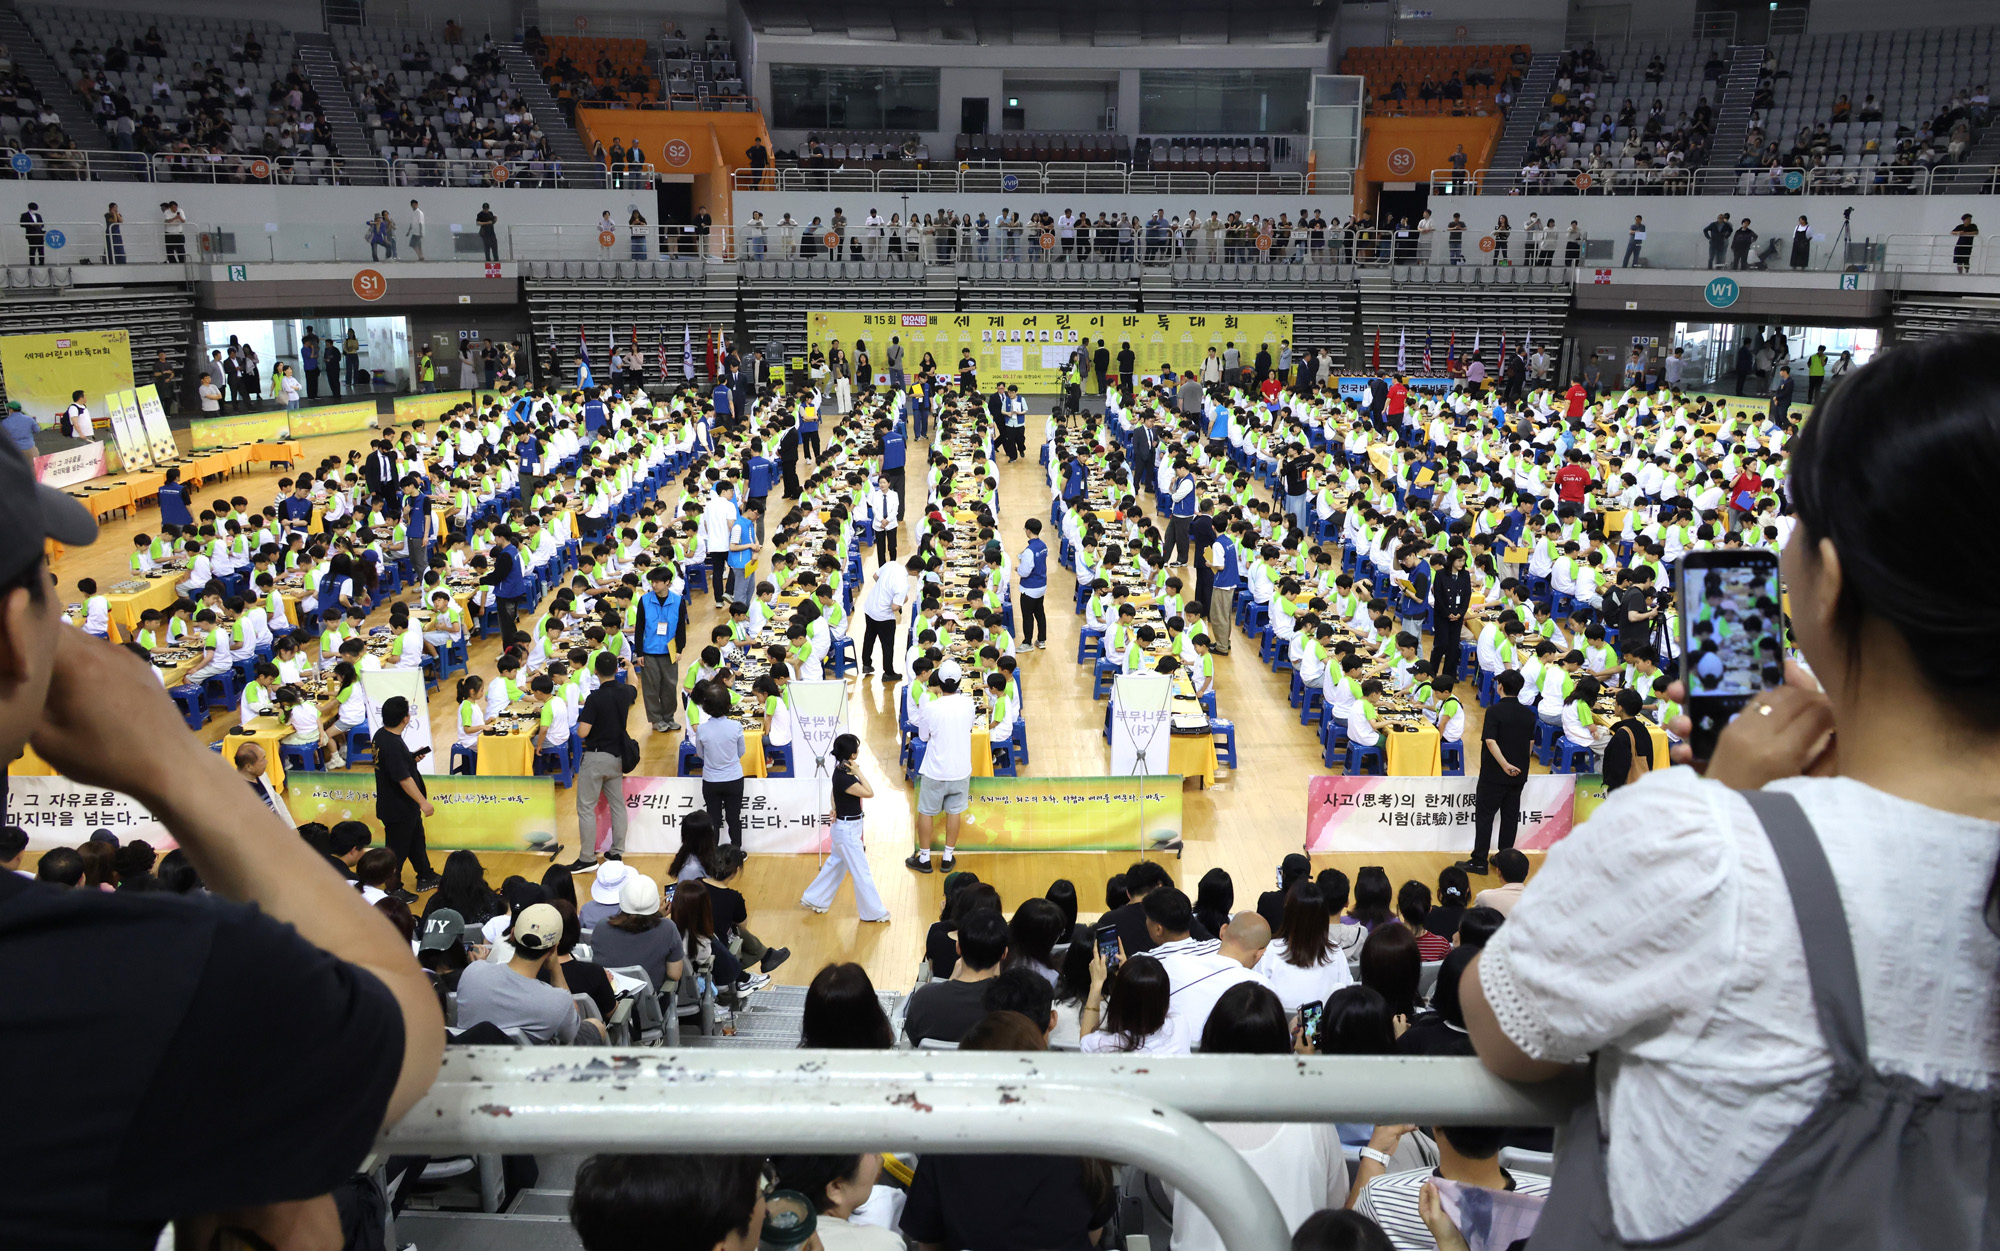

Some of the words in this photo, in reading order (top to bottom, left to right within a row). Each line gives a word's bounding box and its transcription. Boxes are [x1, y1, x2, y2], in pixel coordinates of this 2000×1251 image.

[669, 146, 686, 157] S2
[1393, 154, 1410, 166] S3
[360, 276, 378, 289] S1
[1712, 284, 1732, 297] W1
[24, 794, 39, 806] 그
[49, 791, 128, 808] 자유로움..
[626, 794, 670, 809] 생각!!
[678, 797, 693, 808] 그
[1323, 793, 1415, 808] 사고(思考)의
[1425, 793, 1477, 808] 한계(限
[6, 811, 74, 827] 마지막을
[425, 919, 450, 933] NY
